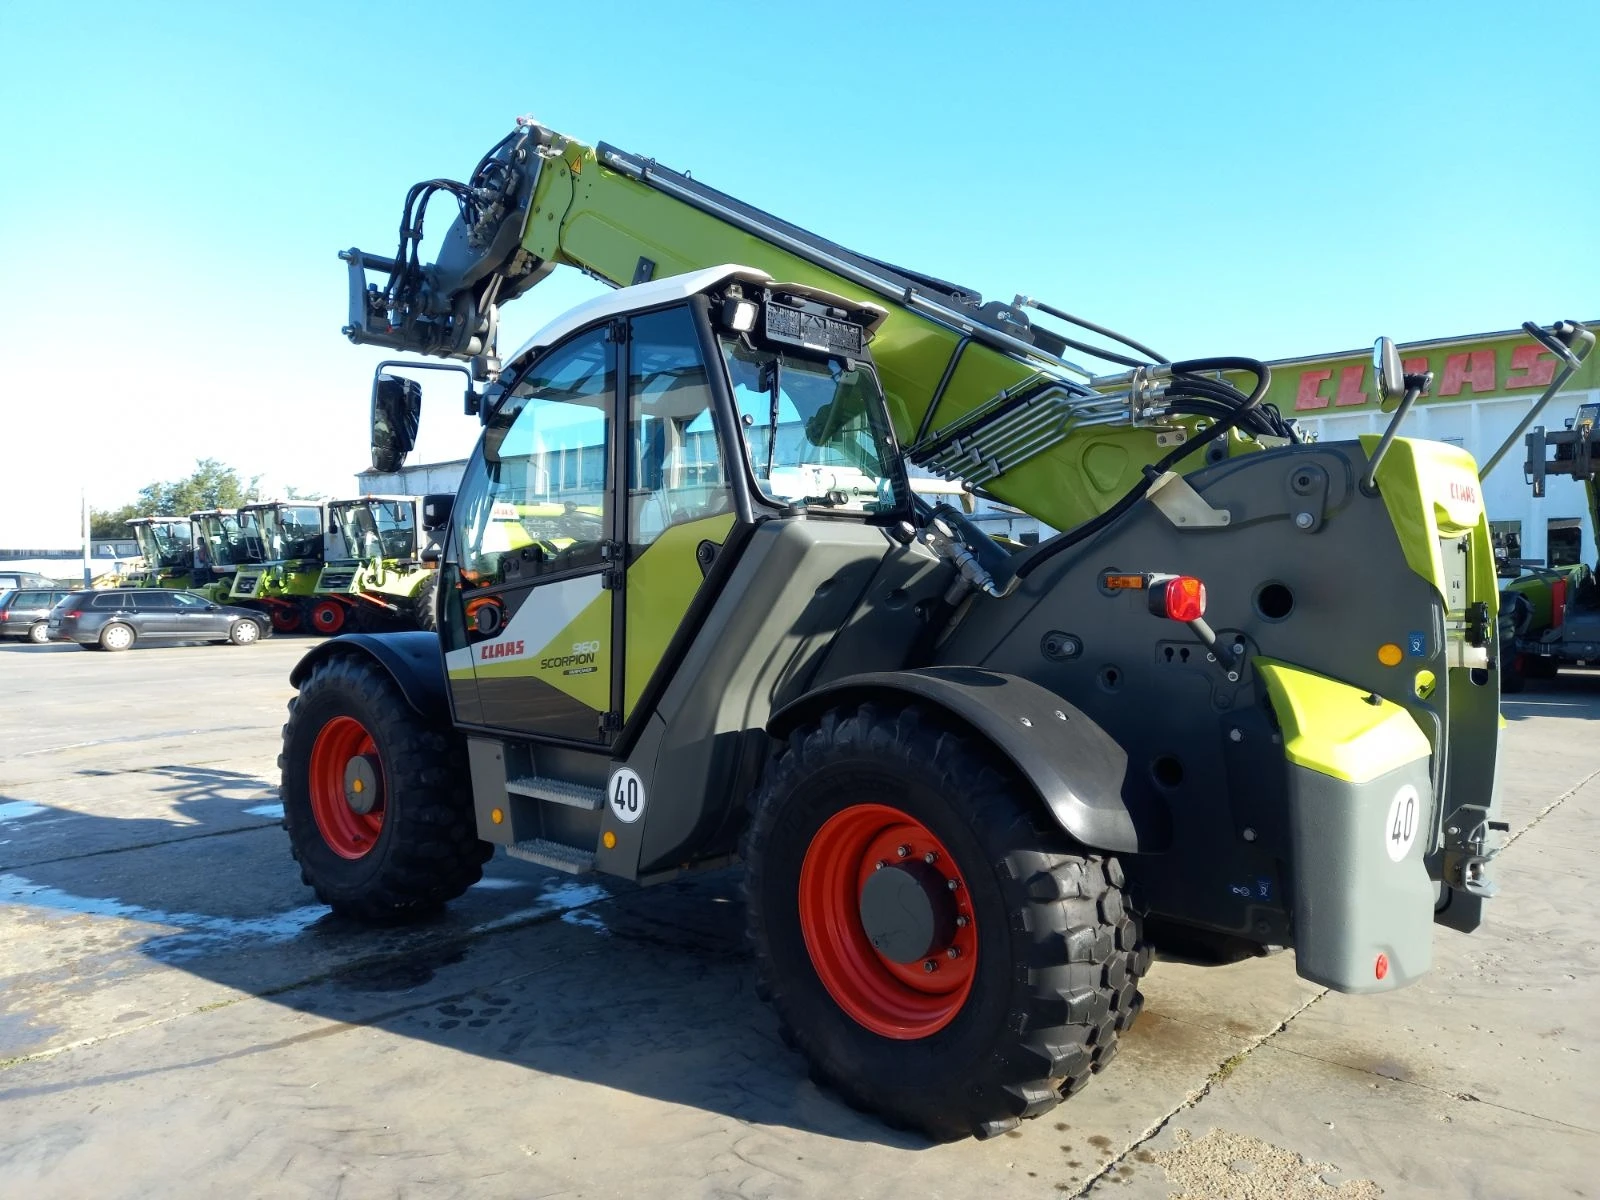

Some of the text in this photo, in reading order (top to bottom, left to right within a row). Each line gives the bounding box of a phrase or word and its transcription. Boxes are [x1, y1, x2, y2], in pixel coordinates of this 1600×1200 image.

[481, 640, 525, 660] CLAAS
[540, 652, 595, 670] SCORPION
[614, 775, 638, 813] 40
[1391, 797, 1414, 845] 40
